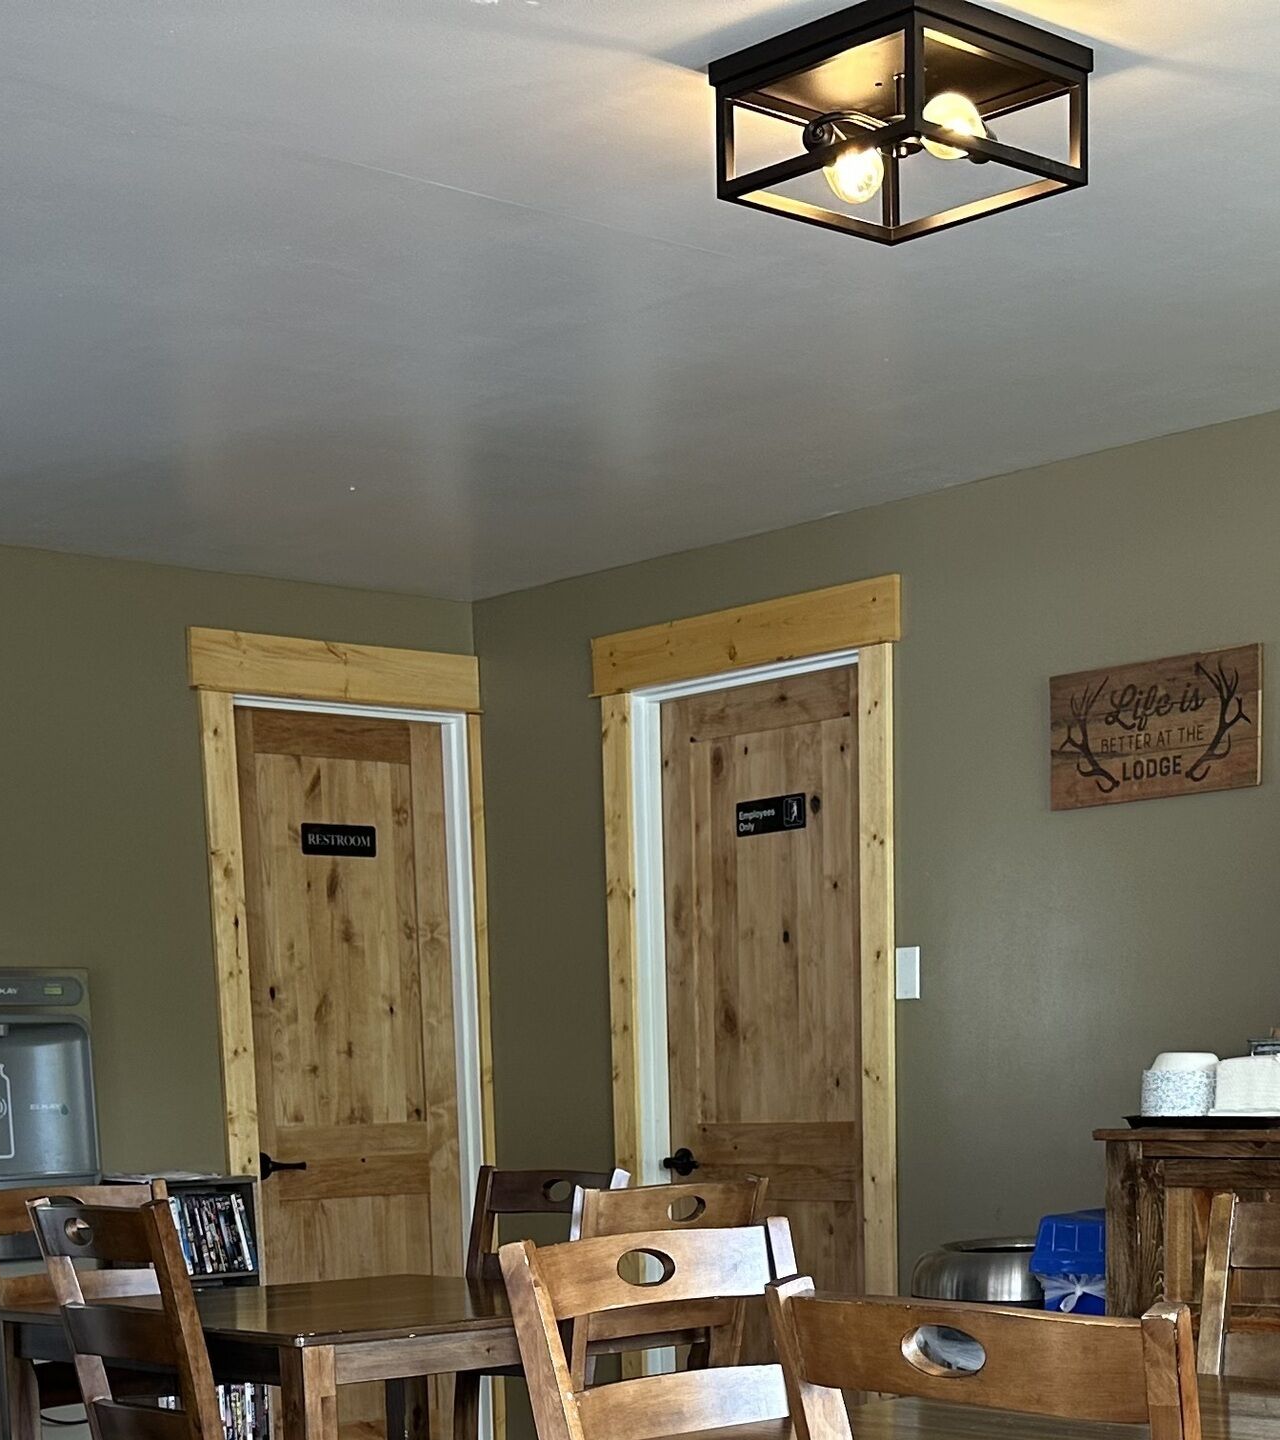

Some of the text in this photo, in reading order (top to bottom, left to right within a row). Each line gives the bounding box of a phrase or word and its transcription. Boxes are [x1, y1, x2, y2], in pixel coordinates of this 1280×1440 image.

[1104, 682, 1206, 731] Life is
[1100, 724, 1205, 753] BETTER AT THE
[1122, 755, 1183, 781] LODGE
[738, 808, 776, 821] Employees
[738, 822, 756, 833] Only
[306, 832, 371, 848] RESTROOM
